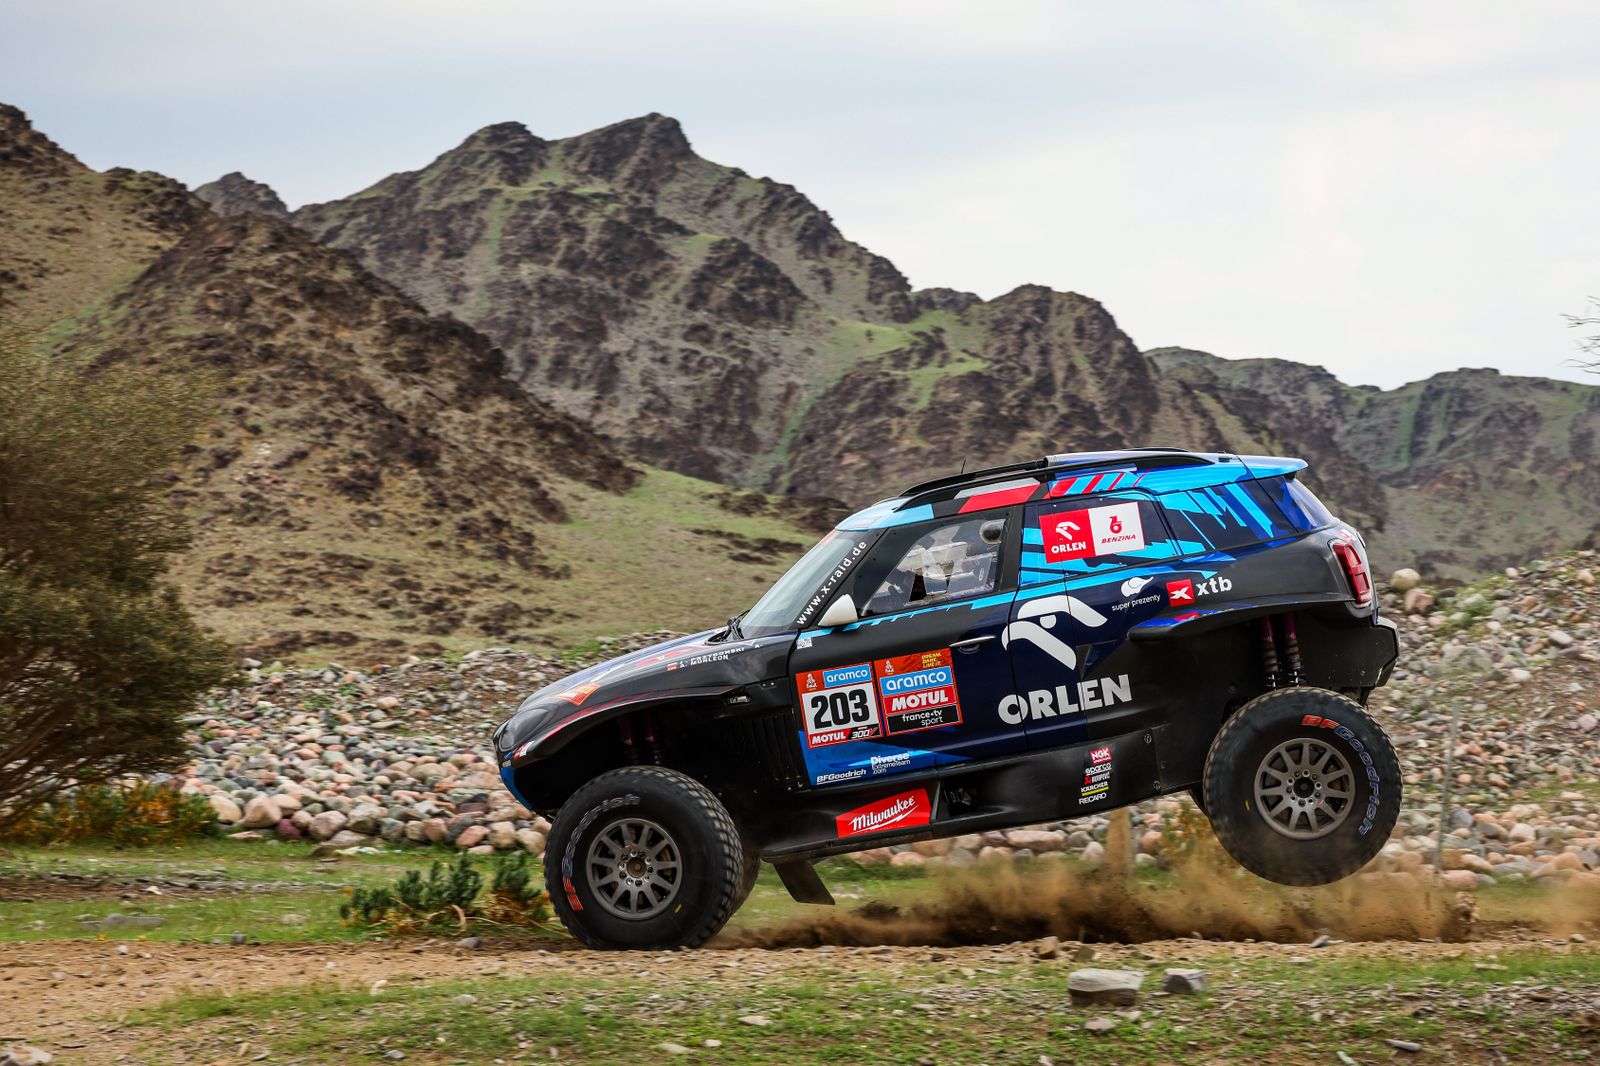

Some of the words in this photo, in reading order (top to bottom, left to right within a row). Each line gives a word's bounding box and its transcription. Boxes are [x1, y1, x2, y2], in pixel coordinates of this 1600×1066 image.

[1101, 534, 1136, 544] BENZINA
[1051, 541, 1087, 554] ORLEN
[796, 541, 867, 626] www.x-raid.de
[1195, 576, 1233, 596] xtb
[1111, 601, 1131, 612] super
[1131, 594, 1161, 607] prezenty
[826, 669, 869, 683] aramco
[886, 671, 947, 691] aramco
[891, 690, 949, 712] MOTUL
[997, 673, 1133, 725] ORLEN
[810, 688, 870, 730] 203
[921, 716, 944, 727] sport
[811, 731, 847, 745] MOTUL
[870, 752, 910, 765] Diverse
[1091, 747, 1110, 761] NGK
[1085, 763, 1112, 774] sparco
[816, 769, 867, 784] BFGoodrich
[1078, 792, 1107, 805] RECARO
[848, 795, 915, 831] Milwaukee
